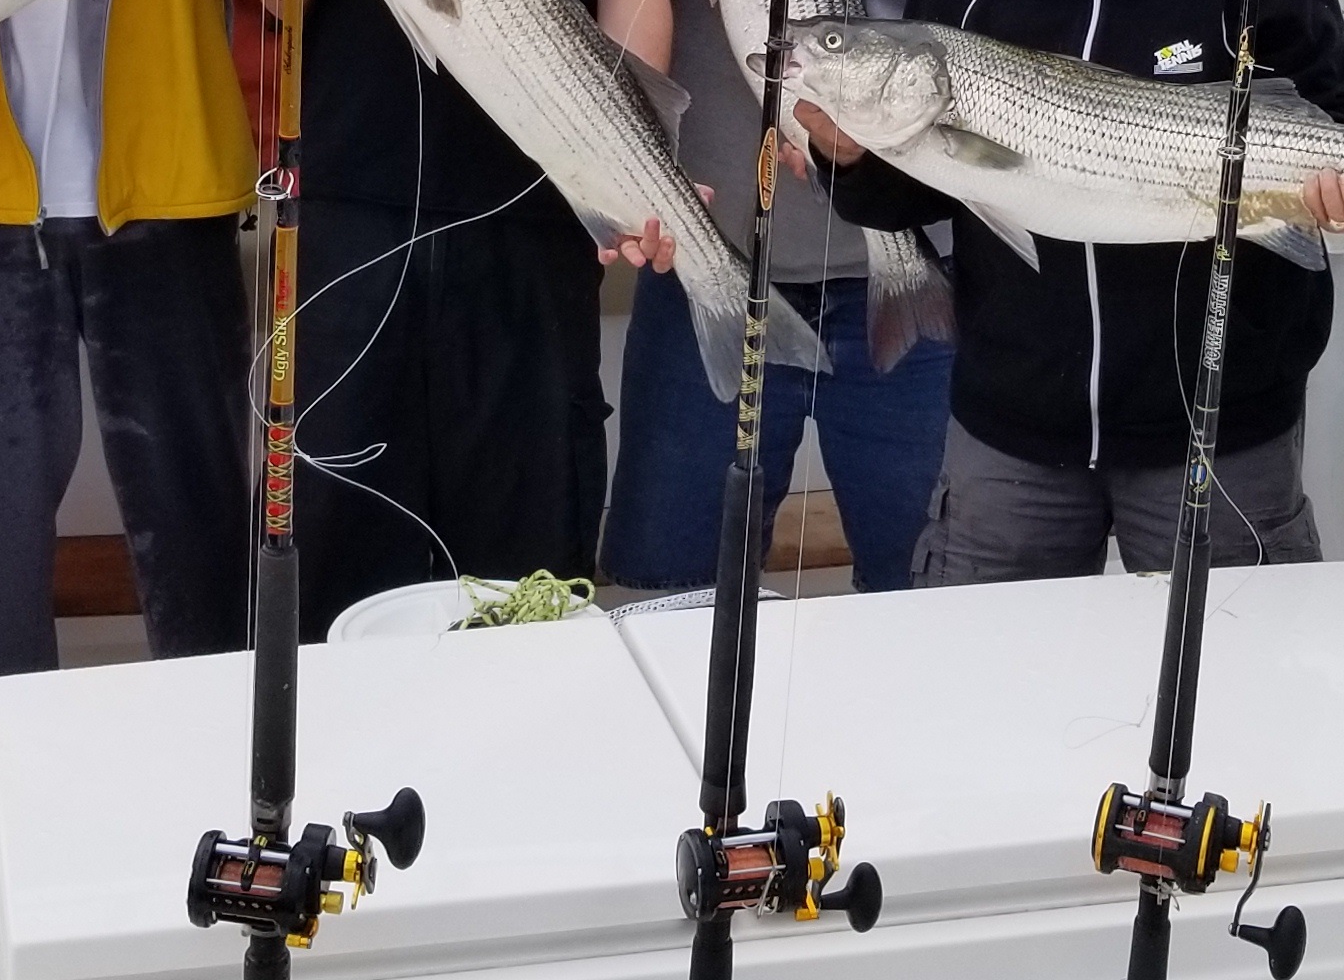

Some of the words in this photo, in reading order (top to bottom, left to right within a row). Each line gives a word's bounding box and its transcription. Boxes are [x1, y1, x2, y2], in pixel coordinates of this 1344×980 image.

[273, 316, 288, 346] Stik
[1203, 315, 1225, 371] POWER
[272, 347, 289, 381] Ugly
